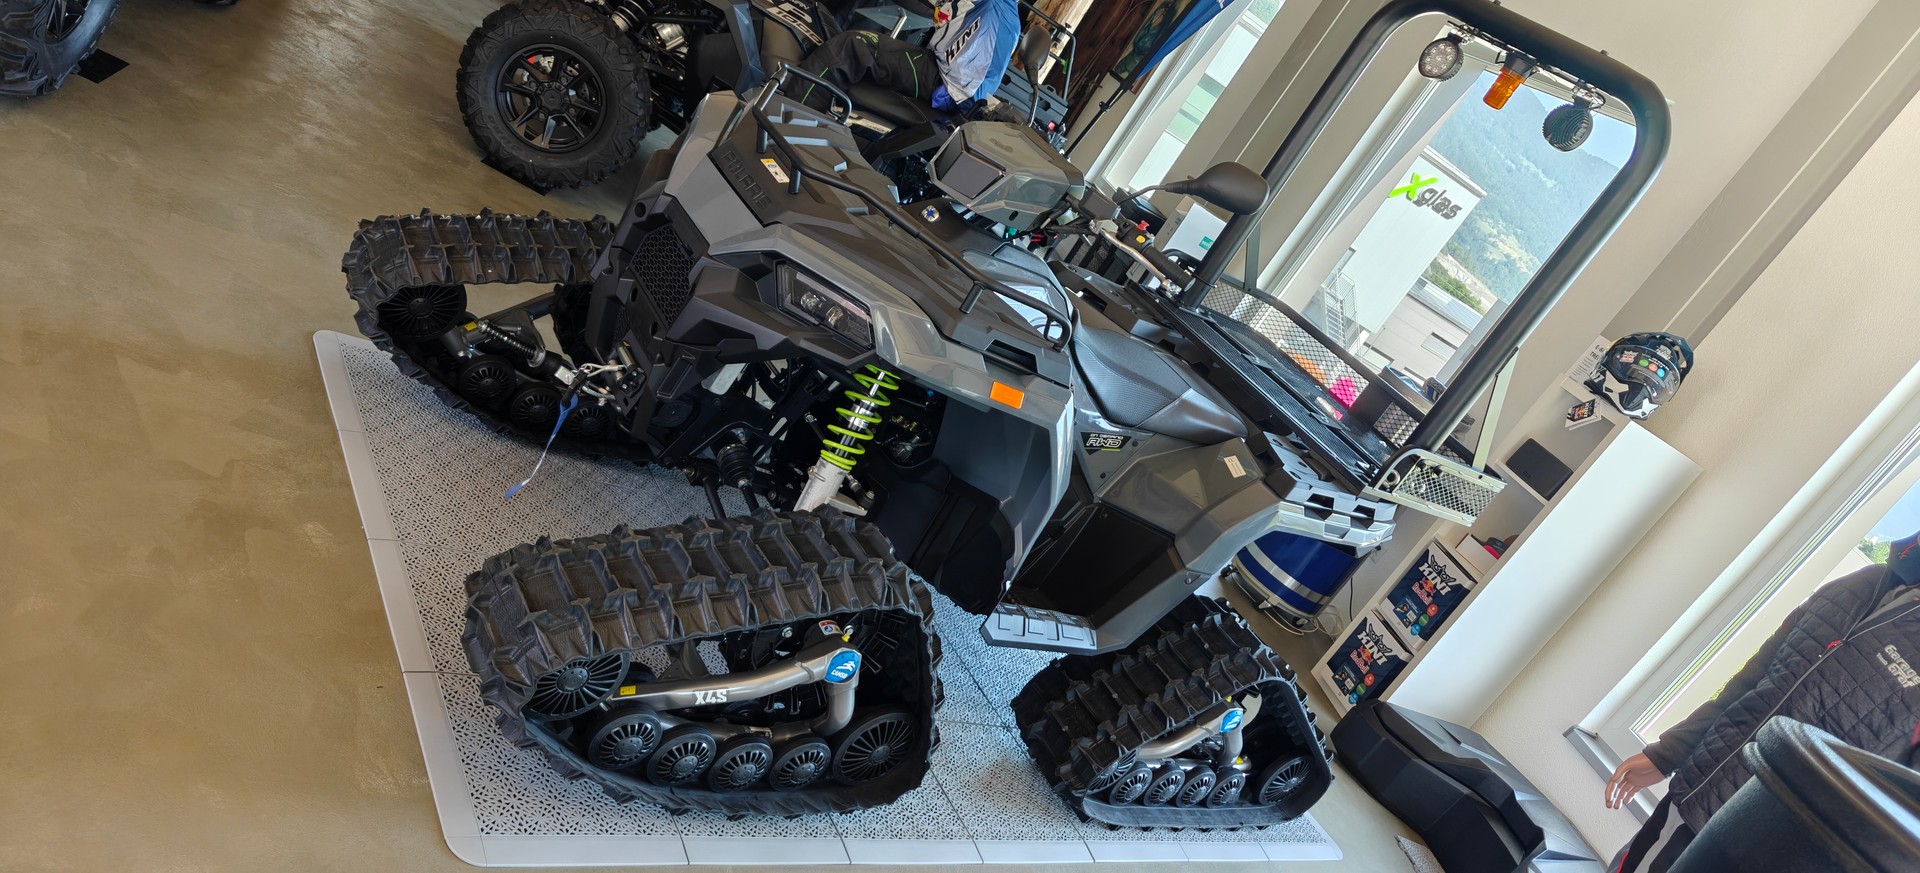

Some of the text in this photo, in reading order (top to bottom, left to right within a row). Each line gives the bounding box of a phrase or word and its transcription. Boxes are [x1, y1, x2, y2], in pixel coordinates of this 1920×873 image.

[944, 16, 981, 65] KINI
[719, 149, 773, 210] POLARIS
[1086, 437, 1122, 448] AWD
[1418, 562, 1452, 596] KINI
[1356, 630, 1388, 666] KINI
[1884, 644, 1920, 684] Garage
[830, 669, 849, 680] CAMSO
[1887, 662, 1916, 688] Graf
[693, 689, 729, 706] X4S
